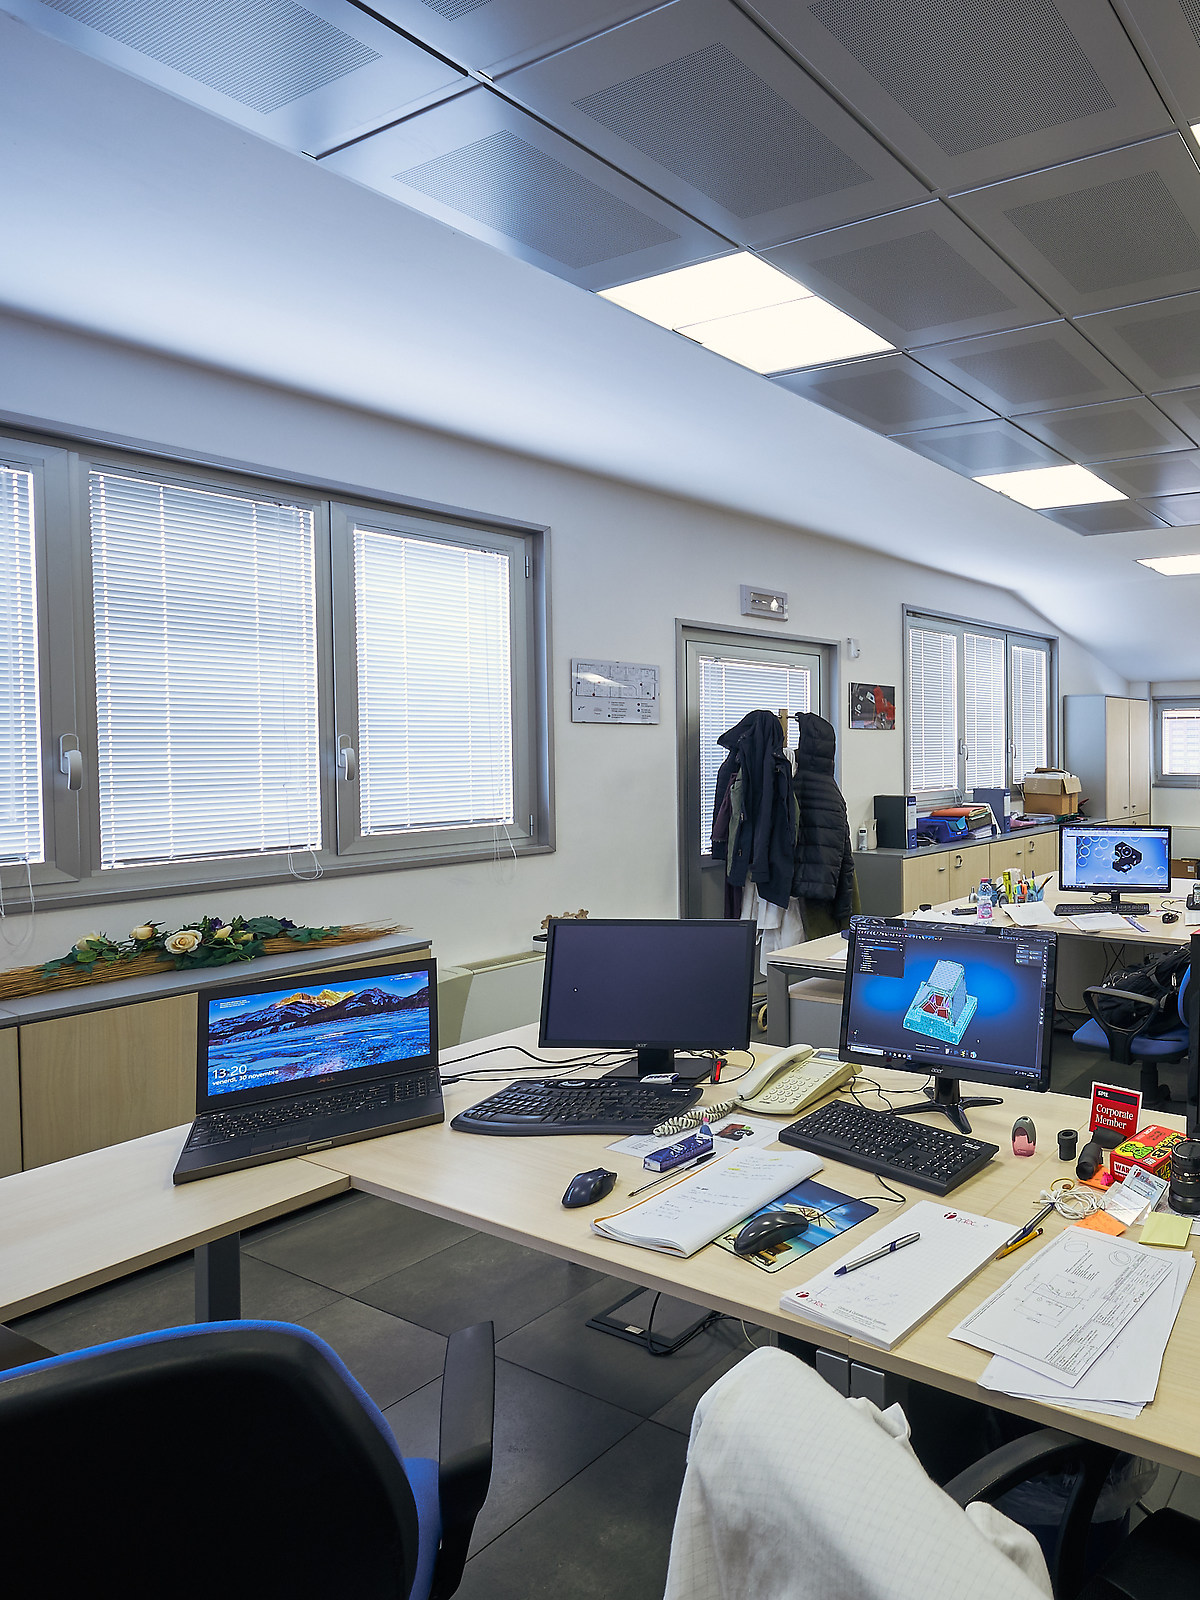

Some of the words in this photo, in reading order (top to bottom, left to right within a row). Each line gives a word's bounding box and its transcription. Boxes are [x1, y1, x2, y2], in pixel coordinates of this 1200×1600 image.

[213, 1064, 247, 1079] 13:20
[248, 1069, 279, 1079] novembre
[1096, 1103, 1134, 1120] Corporate
[1095, 1114, 1127, 1129] Member
[1115, 1162, 1130, 1174] WAR
